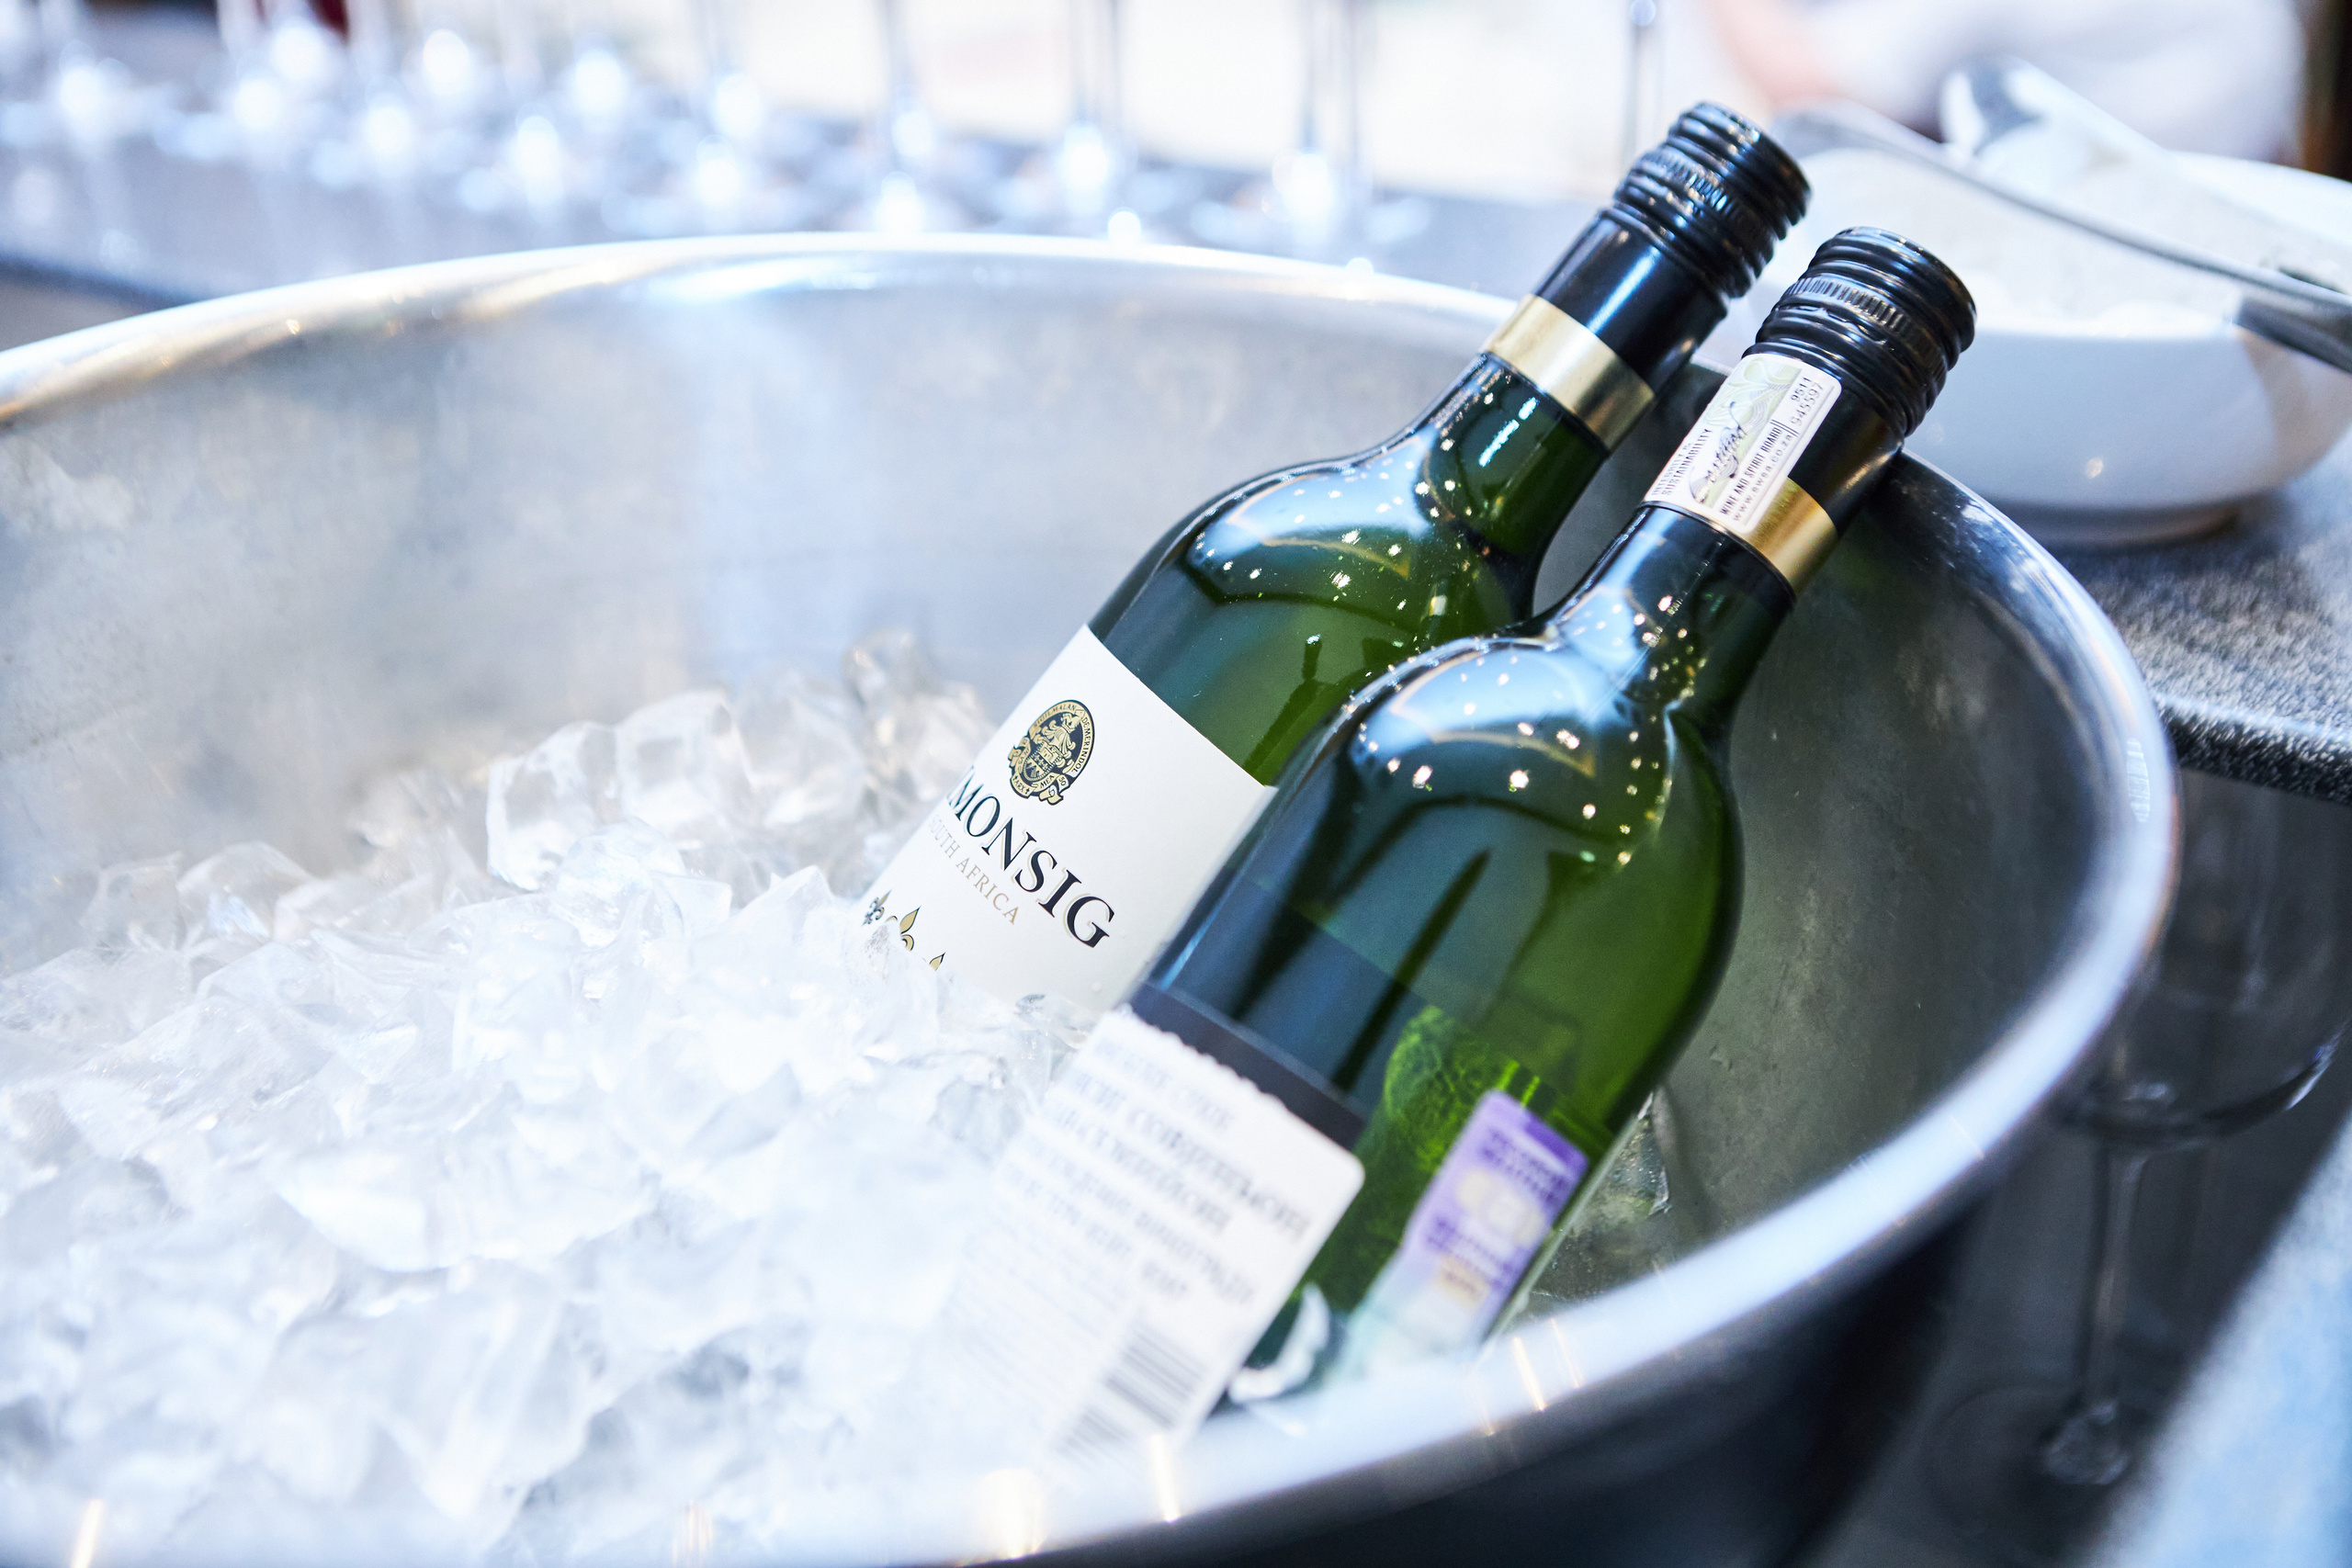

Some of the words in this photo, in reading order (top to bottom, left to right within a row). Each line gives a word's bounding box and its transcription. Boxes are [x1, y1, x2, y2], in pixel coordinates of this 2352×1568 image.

[1790, 381, 1824, 426] 945597
[1791, 377, 1812, 401] 9511
[1661, 428, 1713, 496] SUSTAINABILITY
[1720, 496, 1737, 515] WINE
[1734, 477, 1750, 495] AND
[1744, 452, 1765, 479] SPIRIT
[1759, 426, 1784, 454] BOARD
[1040, 774, 1055, 789] MEA
[931, 818, 961, 860] SOUTH
[956, 857, 1021, 926] AFRICA
